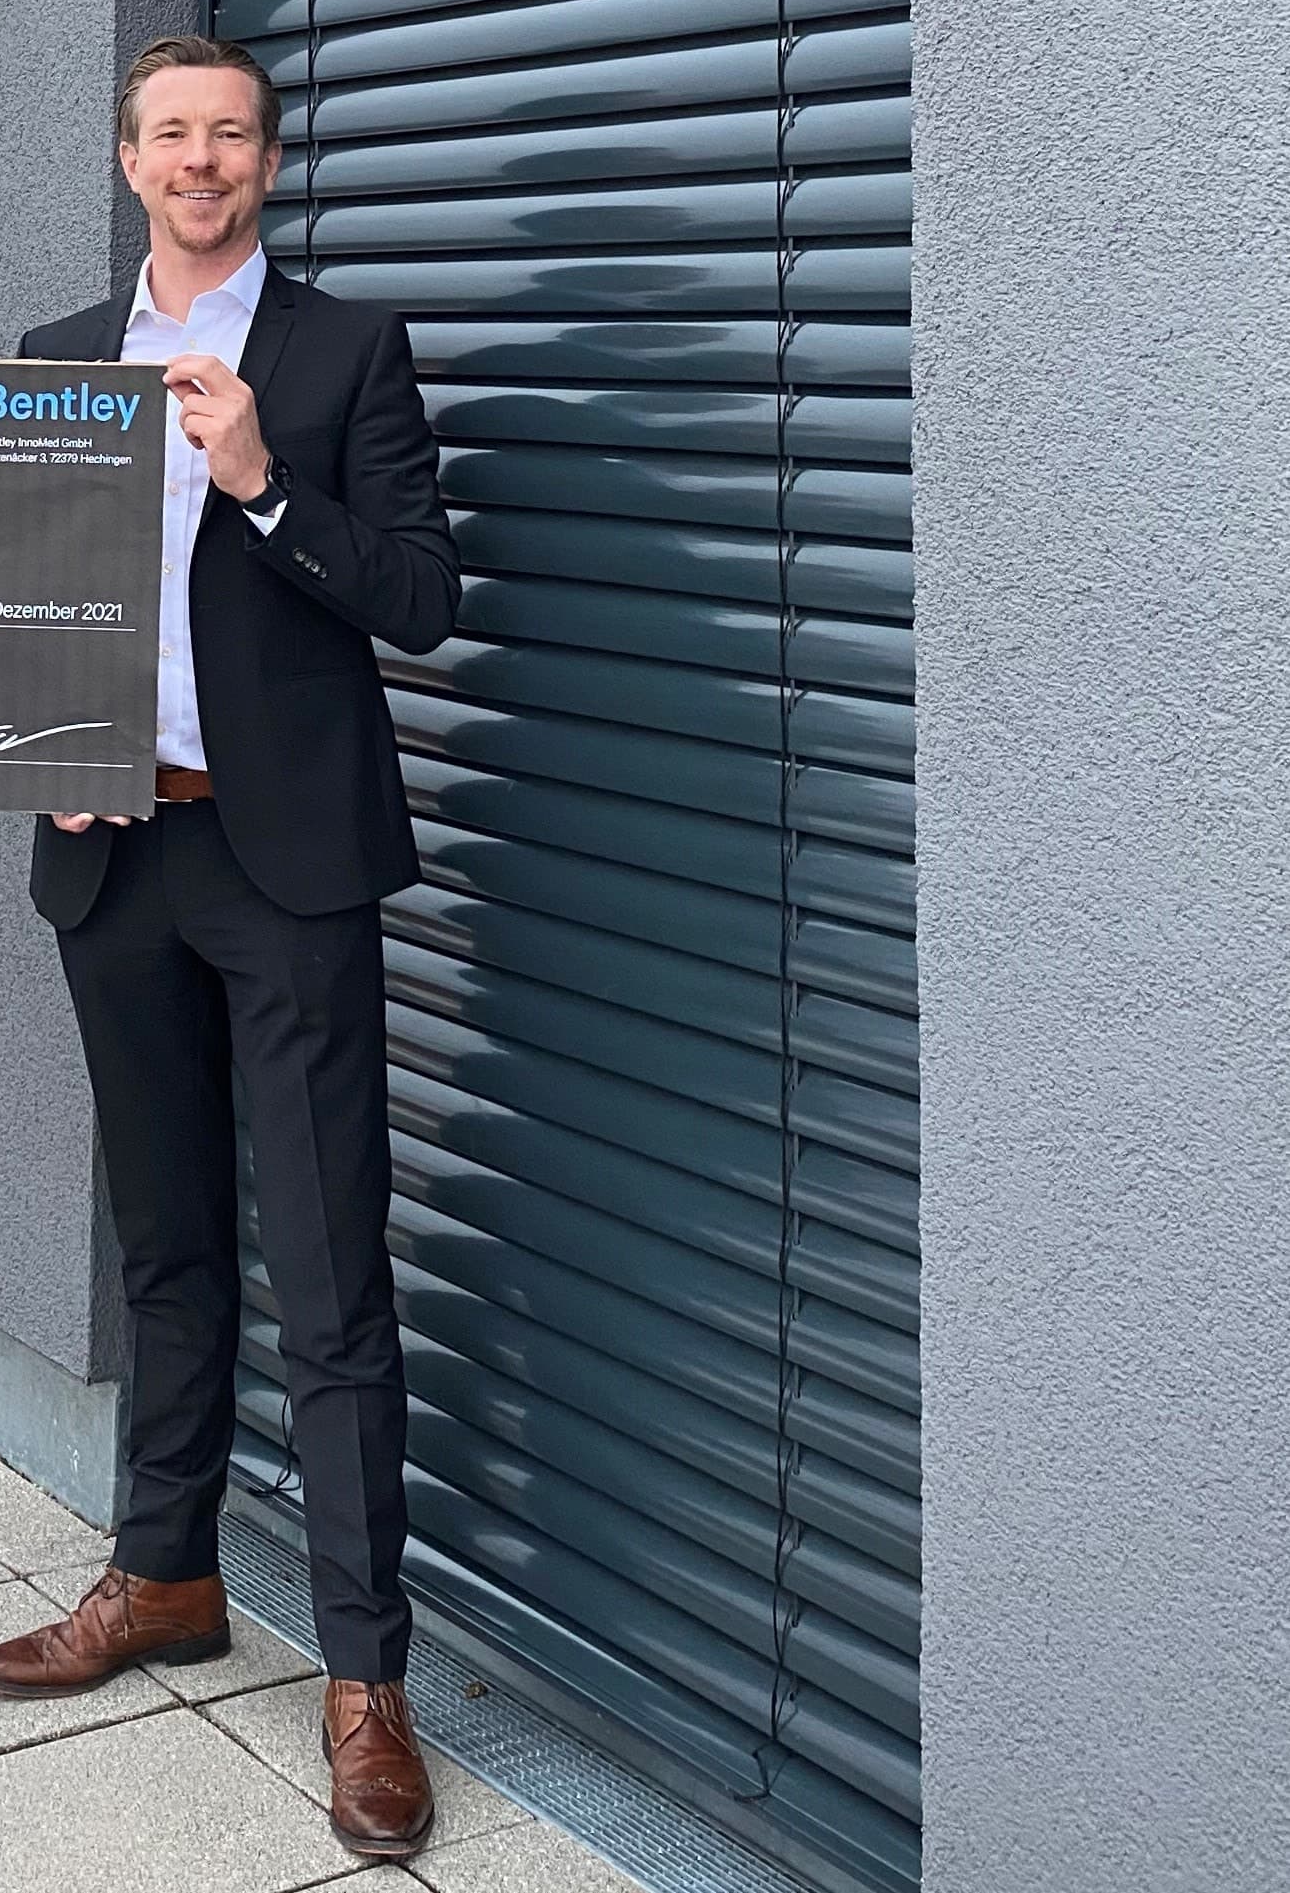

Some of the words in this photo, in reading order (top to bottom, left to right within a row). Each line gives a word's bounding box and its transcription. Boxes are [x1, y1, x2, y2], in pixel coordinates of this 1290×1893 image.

[18, 437, 59, 448] InnoMed
[61, 438, 92, 448] GmbH
[40, 453, 48, 464] 3,
[50, 453, 78, 464] 72379
[80, 454, 132, 467] Hechingen
[81, 603, 122, 621] 2021
